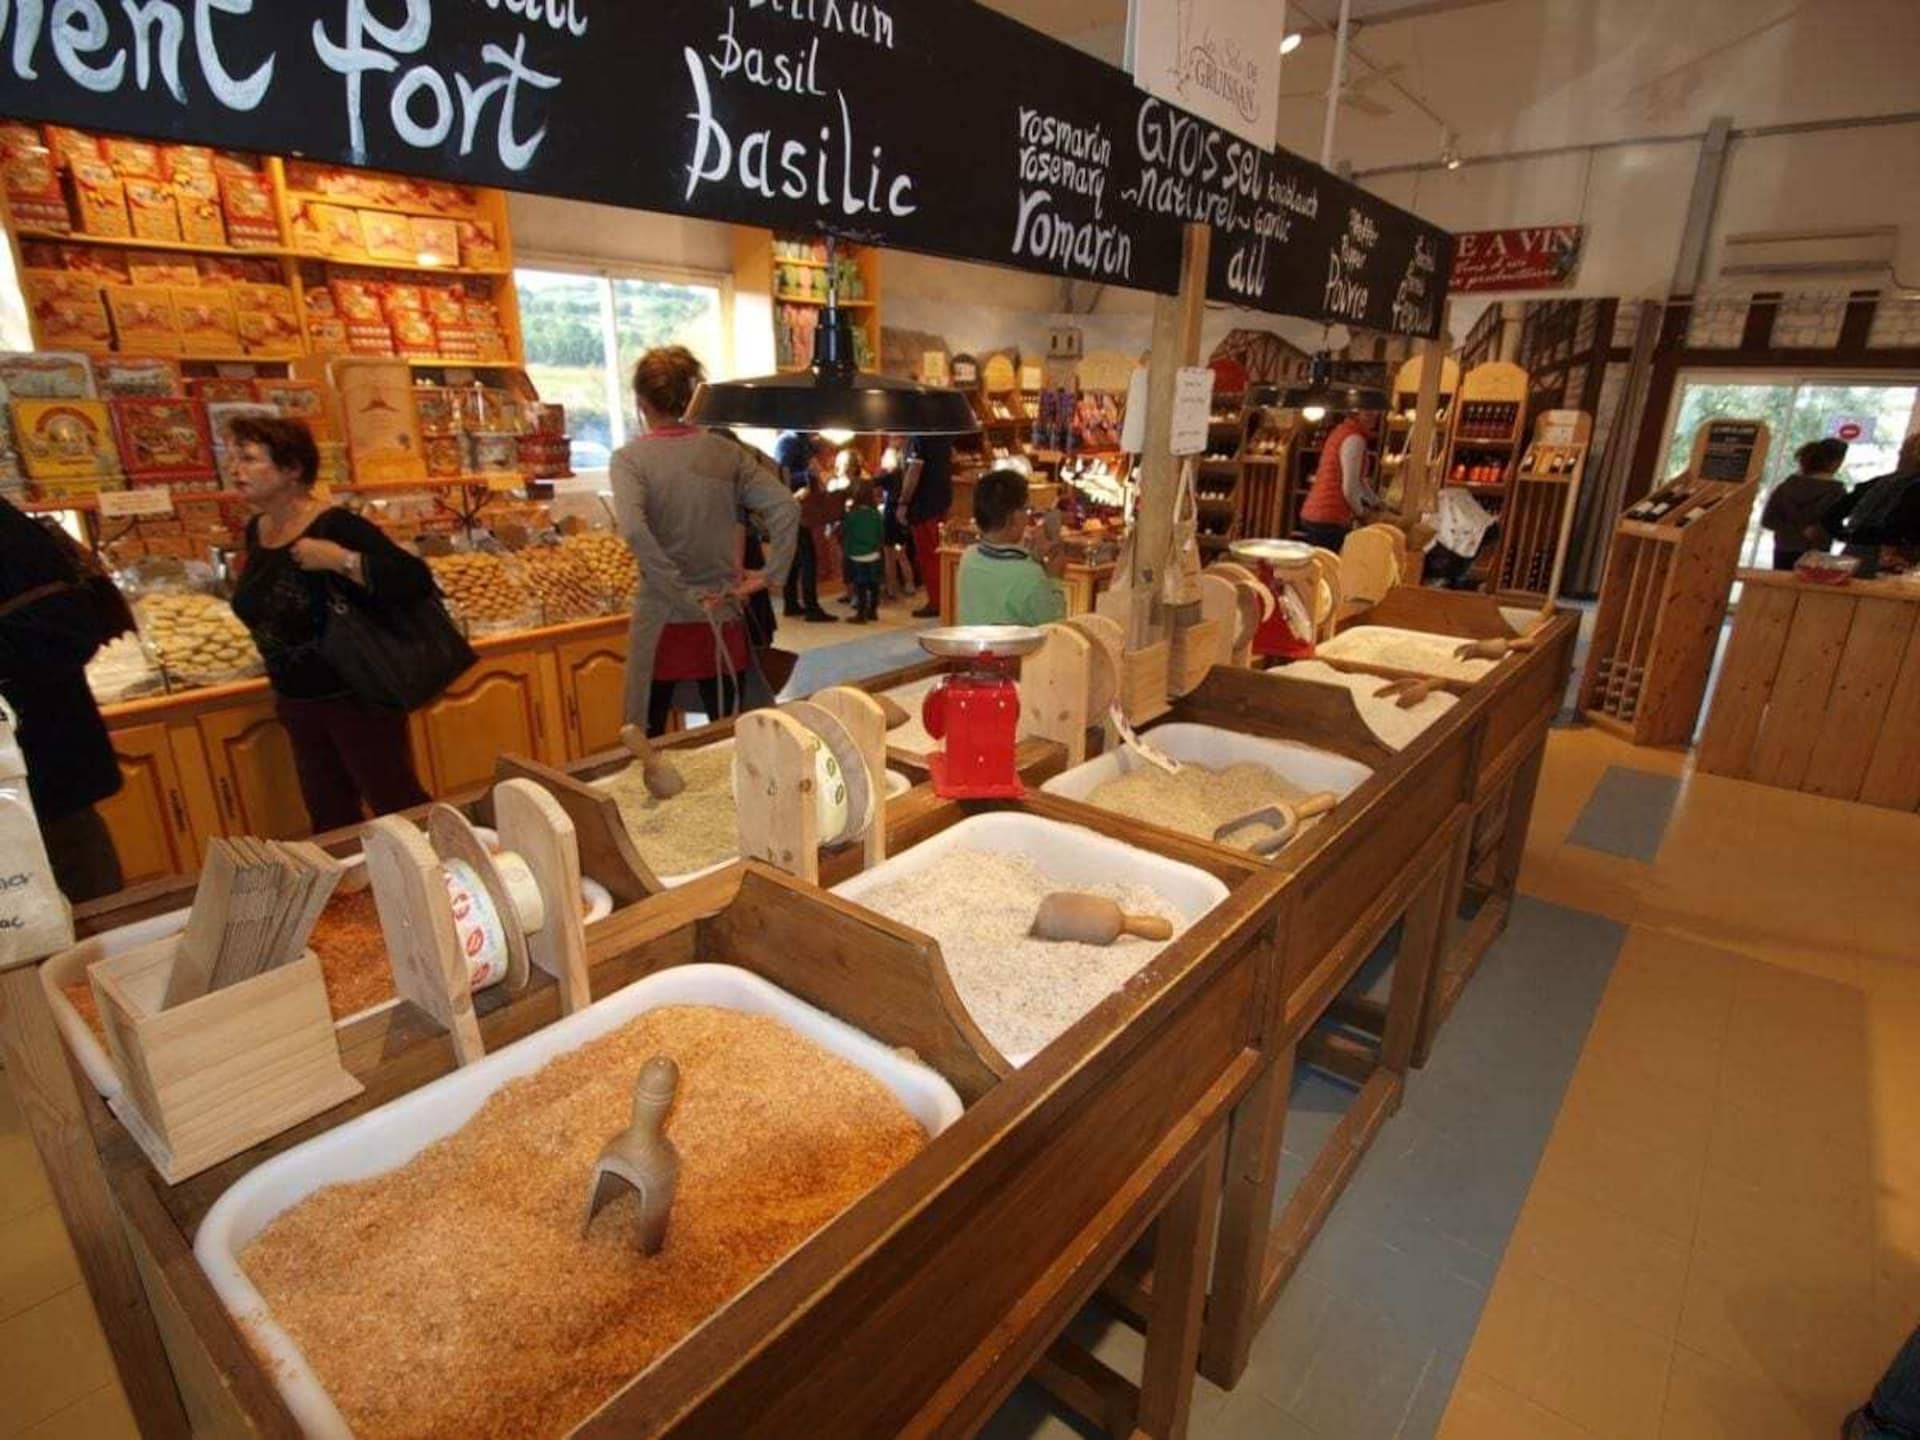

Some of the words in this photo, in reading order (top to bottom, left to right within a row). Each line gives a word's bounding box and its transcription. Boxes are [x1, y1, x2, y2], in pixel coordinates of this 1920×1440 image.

[708, 5, 827, 95] basil
[684, 45, 917, 216] basilic
[1019, 105, 1111, 168] rosmarin
[1136, 97, 1220, 183] Gros
[1019, 146, 1105, 220] rosemary
[1012, 188, 1131, 280] romarin
[1227, 236, 1267, 297] ail
[1519, 226, 1578, 254] VIN
